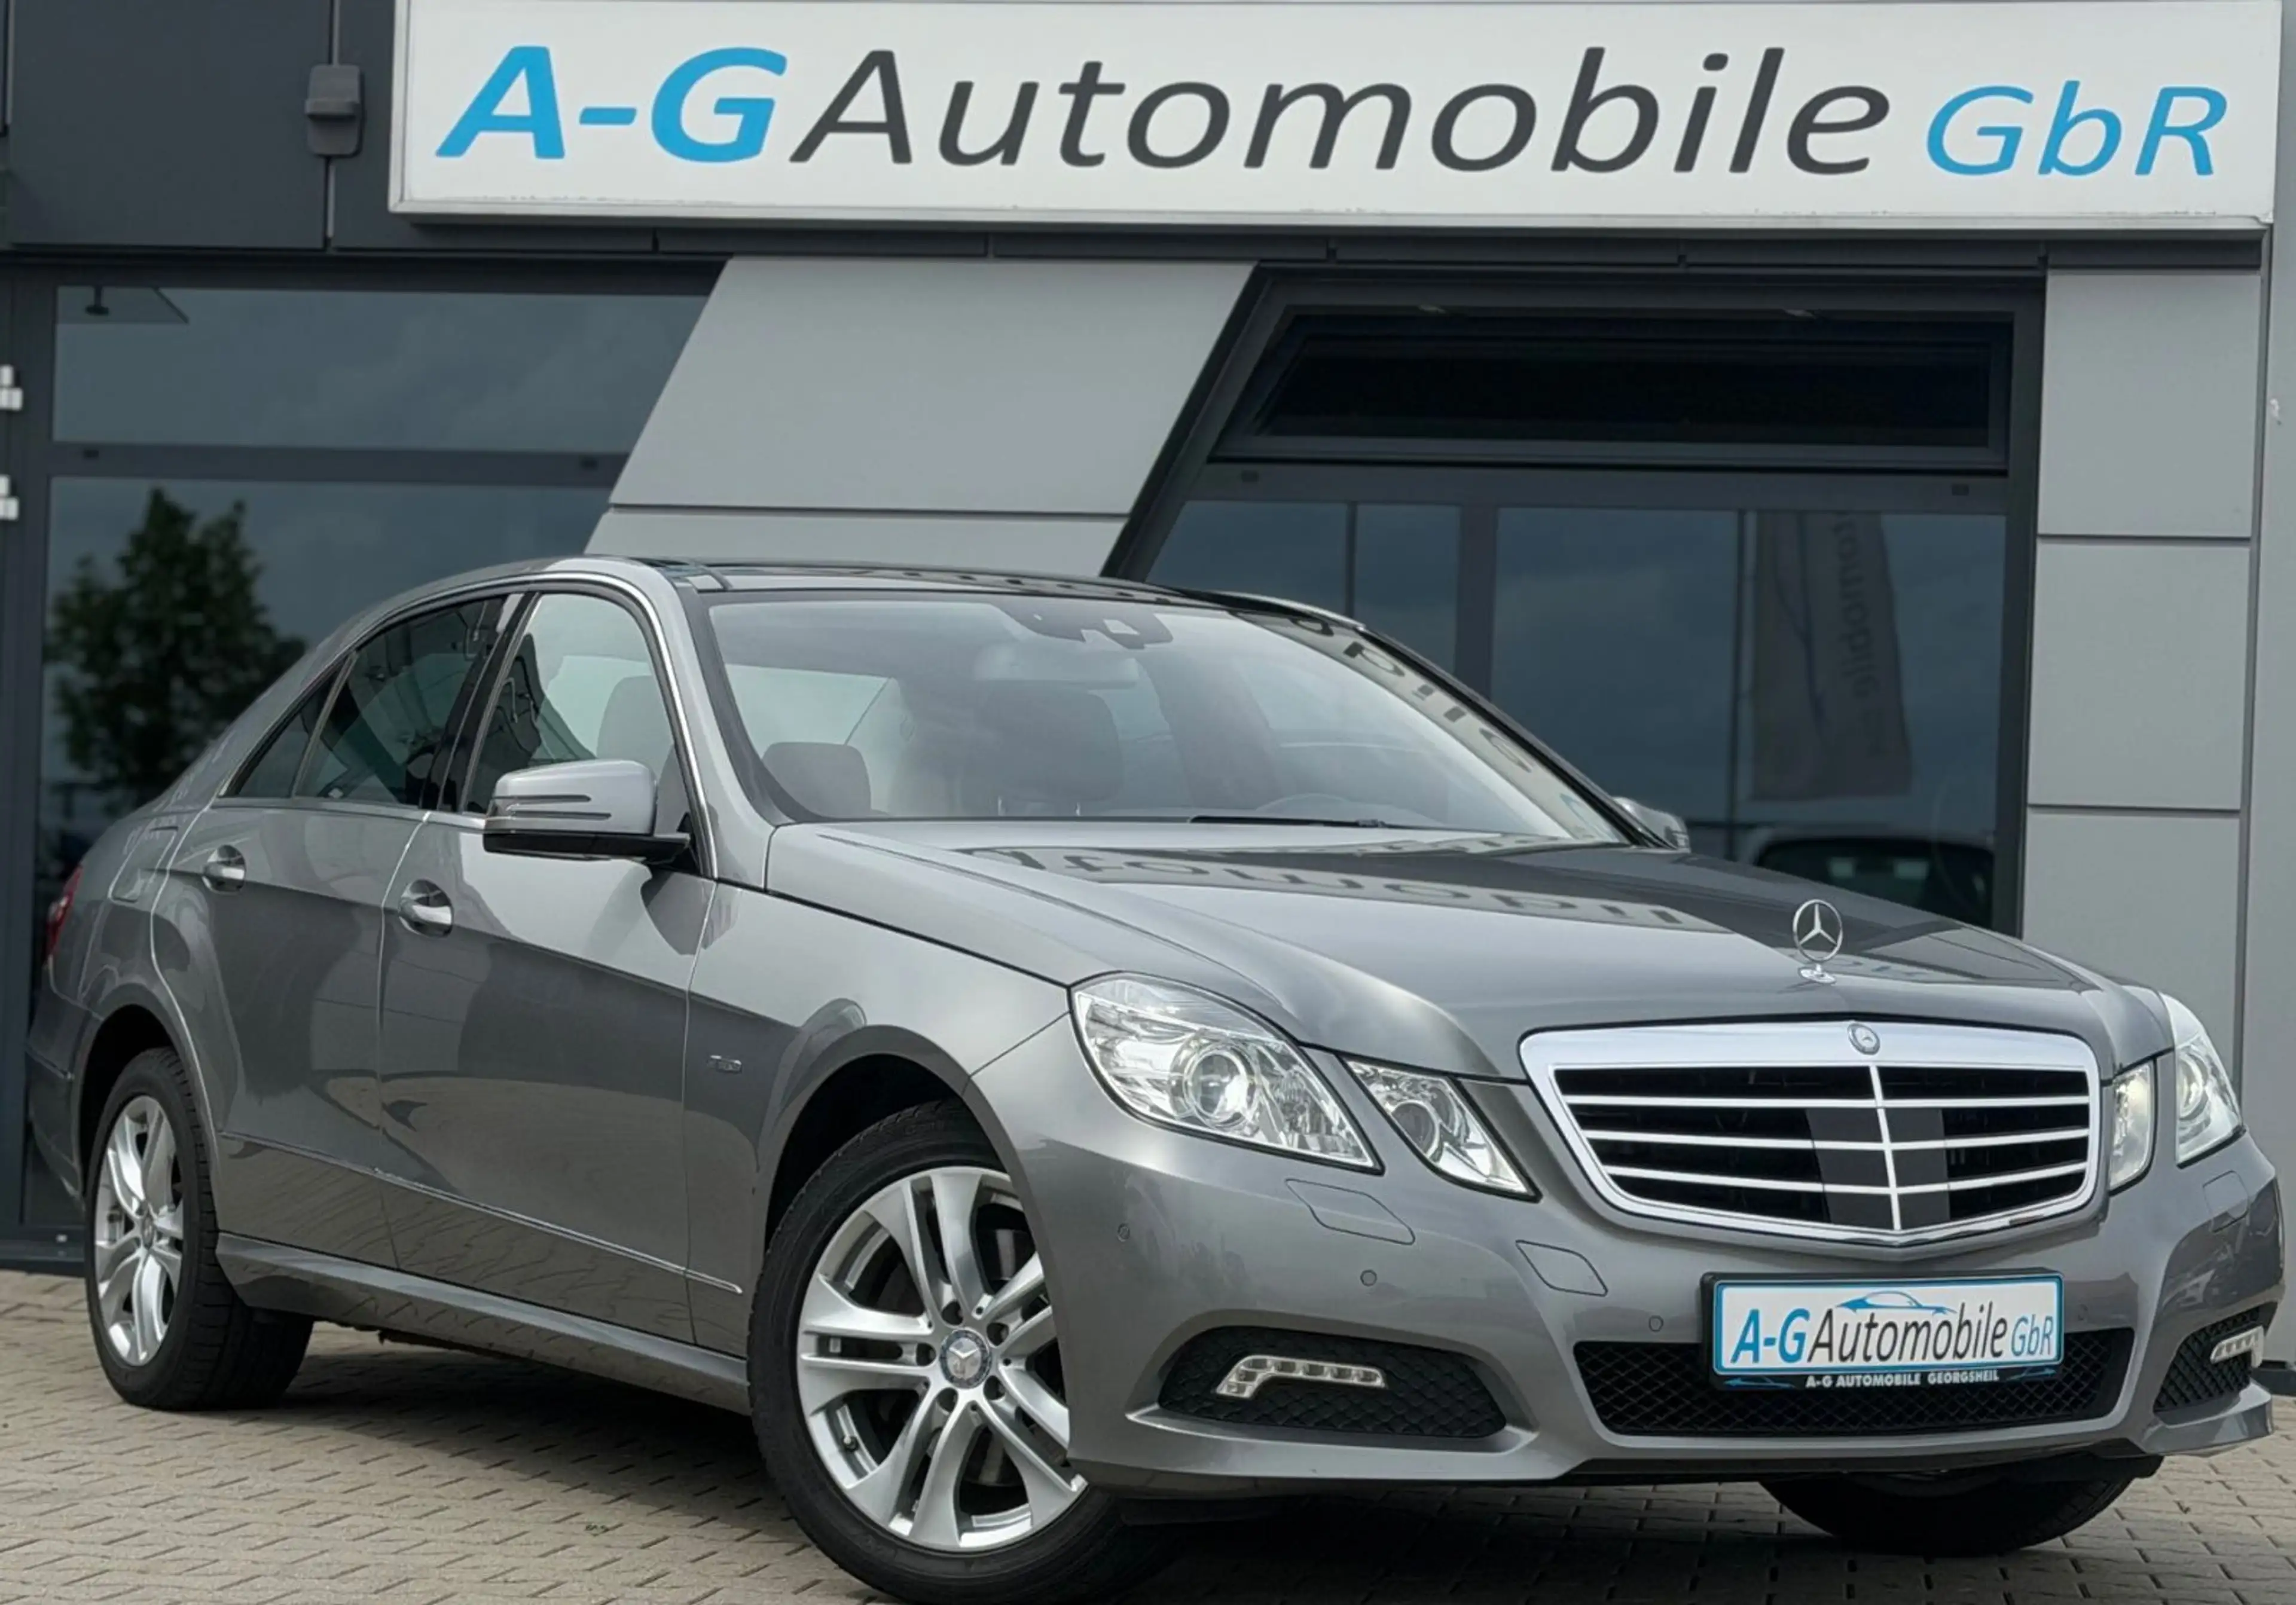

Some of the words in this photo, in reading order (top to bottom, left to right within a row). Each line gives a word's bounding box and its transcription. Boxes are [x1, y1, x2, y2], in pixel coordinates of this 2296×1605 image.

[436, 45, 787, 163] A-G
[789, 47, 1889, 175] Automobile
[1927, 80, 2227, 176] GbR
[1730, 1308, 1810, 1364] A-G
[1808, 1301, 2008, 1363] Automobile
[2011, 1313, 2054, 1357] GbR
[1806, 1375, 1833, 1388] A-G
[1836, 1372, 1921, 1387] AUTOMOBILE
[1927, 1369, 1999, 1384] GEORGSHEIL
